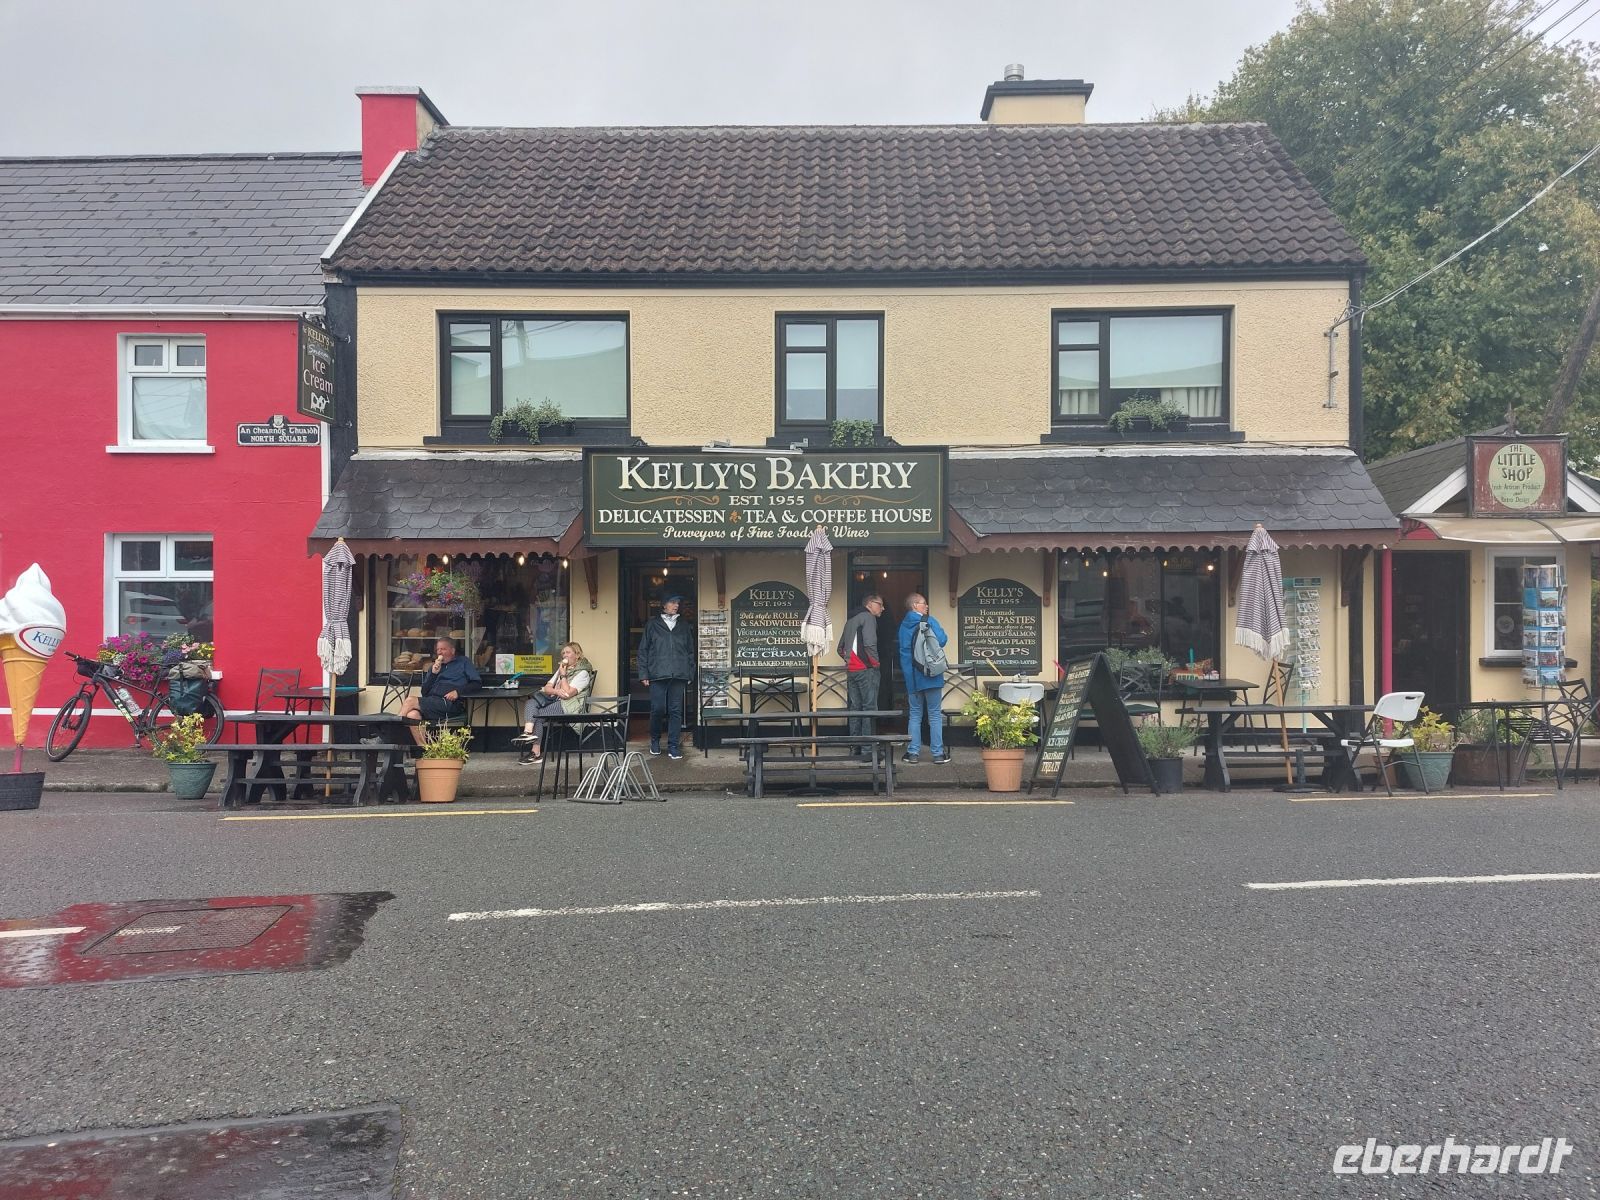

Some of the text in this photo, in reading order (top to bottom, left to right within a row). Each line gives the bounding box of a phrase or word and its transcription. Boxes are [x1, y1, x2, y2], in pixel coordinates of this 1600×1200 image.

[307, 327, 330, 346] KELLY'S
[312, 355, 326, 374] Ice
[303, 369, 334, 395] Cream
[1497, 453, 1536, 466] LITTLE
[617, 456, 918, 490] KELLY'S BAKERY
[1502, 467, 1533, 481] SHOP
[729, 495, 805, 506] EST 1955
[598, 508, 933, 524] DELICATESSEN TEA & COFFEE HOUSE
[663, 526, 726, 540] Purveyors
[730, 526, 744, 541] of
[746, 526, 775, 539] Fine
[777, 526, 815, 539] Foods
[832, 525, 870, 538] Wines
[749, 589, 795, 600] KELLY'S
[977, 586, 1024, 598] KELLY'S
[755, 612, 772, 621] style
[964, 616, 1036, 624] PIES & PASTIES
[736, 628, 779, 637] VEGETARIAN
[978, 629, 1007, 637] SMOKED
[1008, 629, 1036, 637] SALMON
[766, 636, 805, 645] CHEESES
[736, 650, 807, 658] ICE CREAM
[971, 647, 1030, 658] SOUPS
